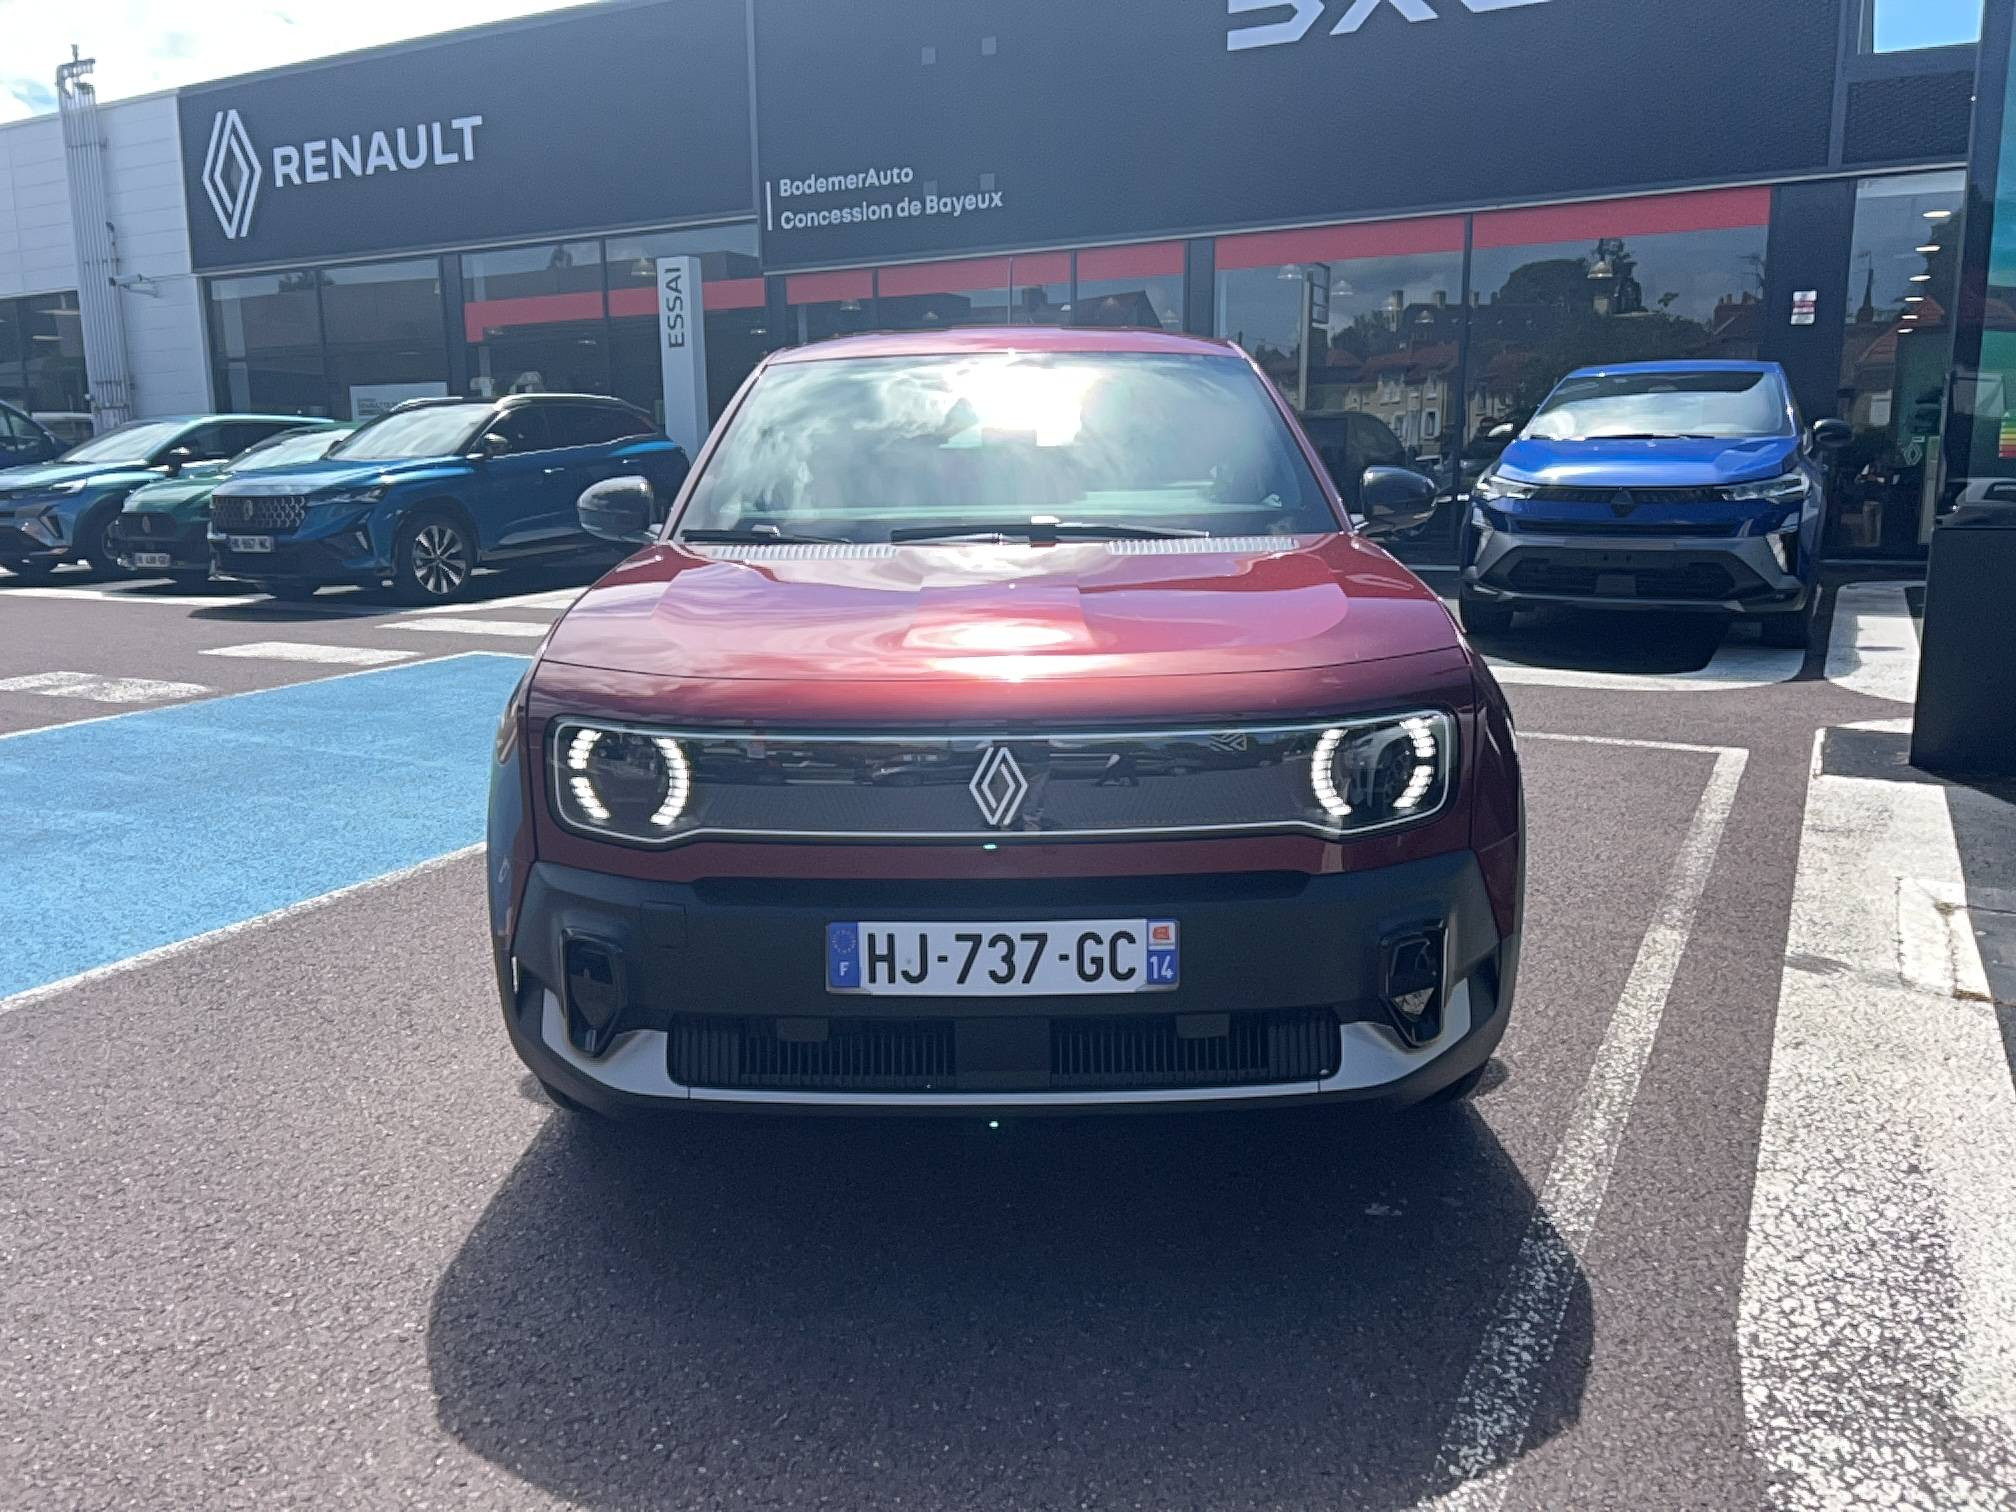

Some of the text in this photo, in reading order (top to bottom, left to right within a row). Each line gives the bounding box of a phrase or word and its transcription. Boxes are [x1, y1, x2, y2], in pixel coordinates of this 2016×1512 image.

[272, 114, 483, 188] RENAULT
[779, 166, 914, 198] BodemerAuto
[780, 191, 1003, 230] Concession de Bayeux
[664, 266, 685, 349] ESSAI
[839, 961, 849, 977] F
[867, 930, 1137, 985] HJ-737-GC
[1149, 955, 1175, 980] 14
